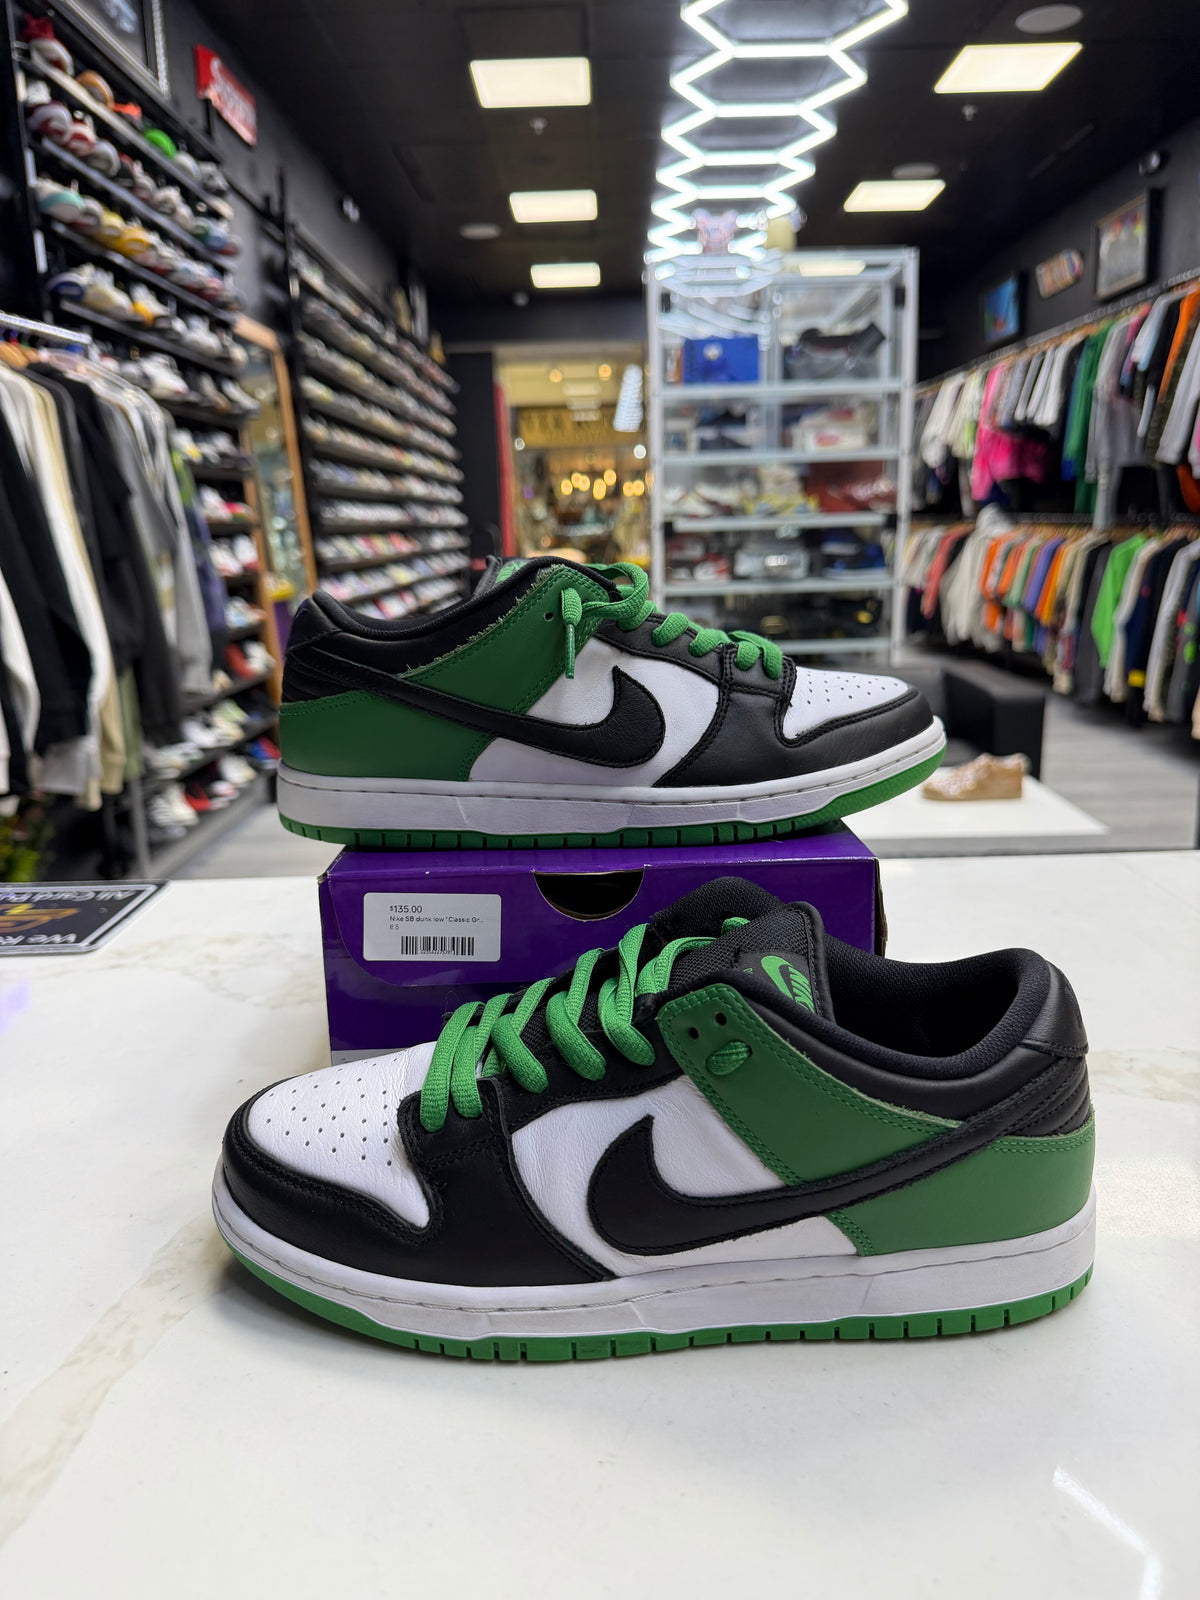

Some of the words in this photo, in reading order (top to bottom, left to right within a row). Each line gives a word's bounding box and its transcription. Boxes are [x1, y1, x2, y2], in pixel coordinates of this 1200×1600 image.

[31, 890, 96, 902] Card
[96, 890, 137, 901] All
[389, 904, 423, 914] $135.00
[27, 933, 77, 944] We
